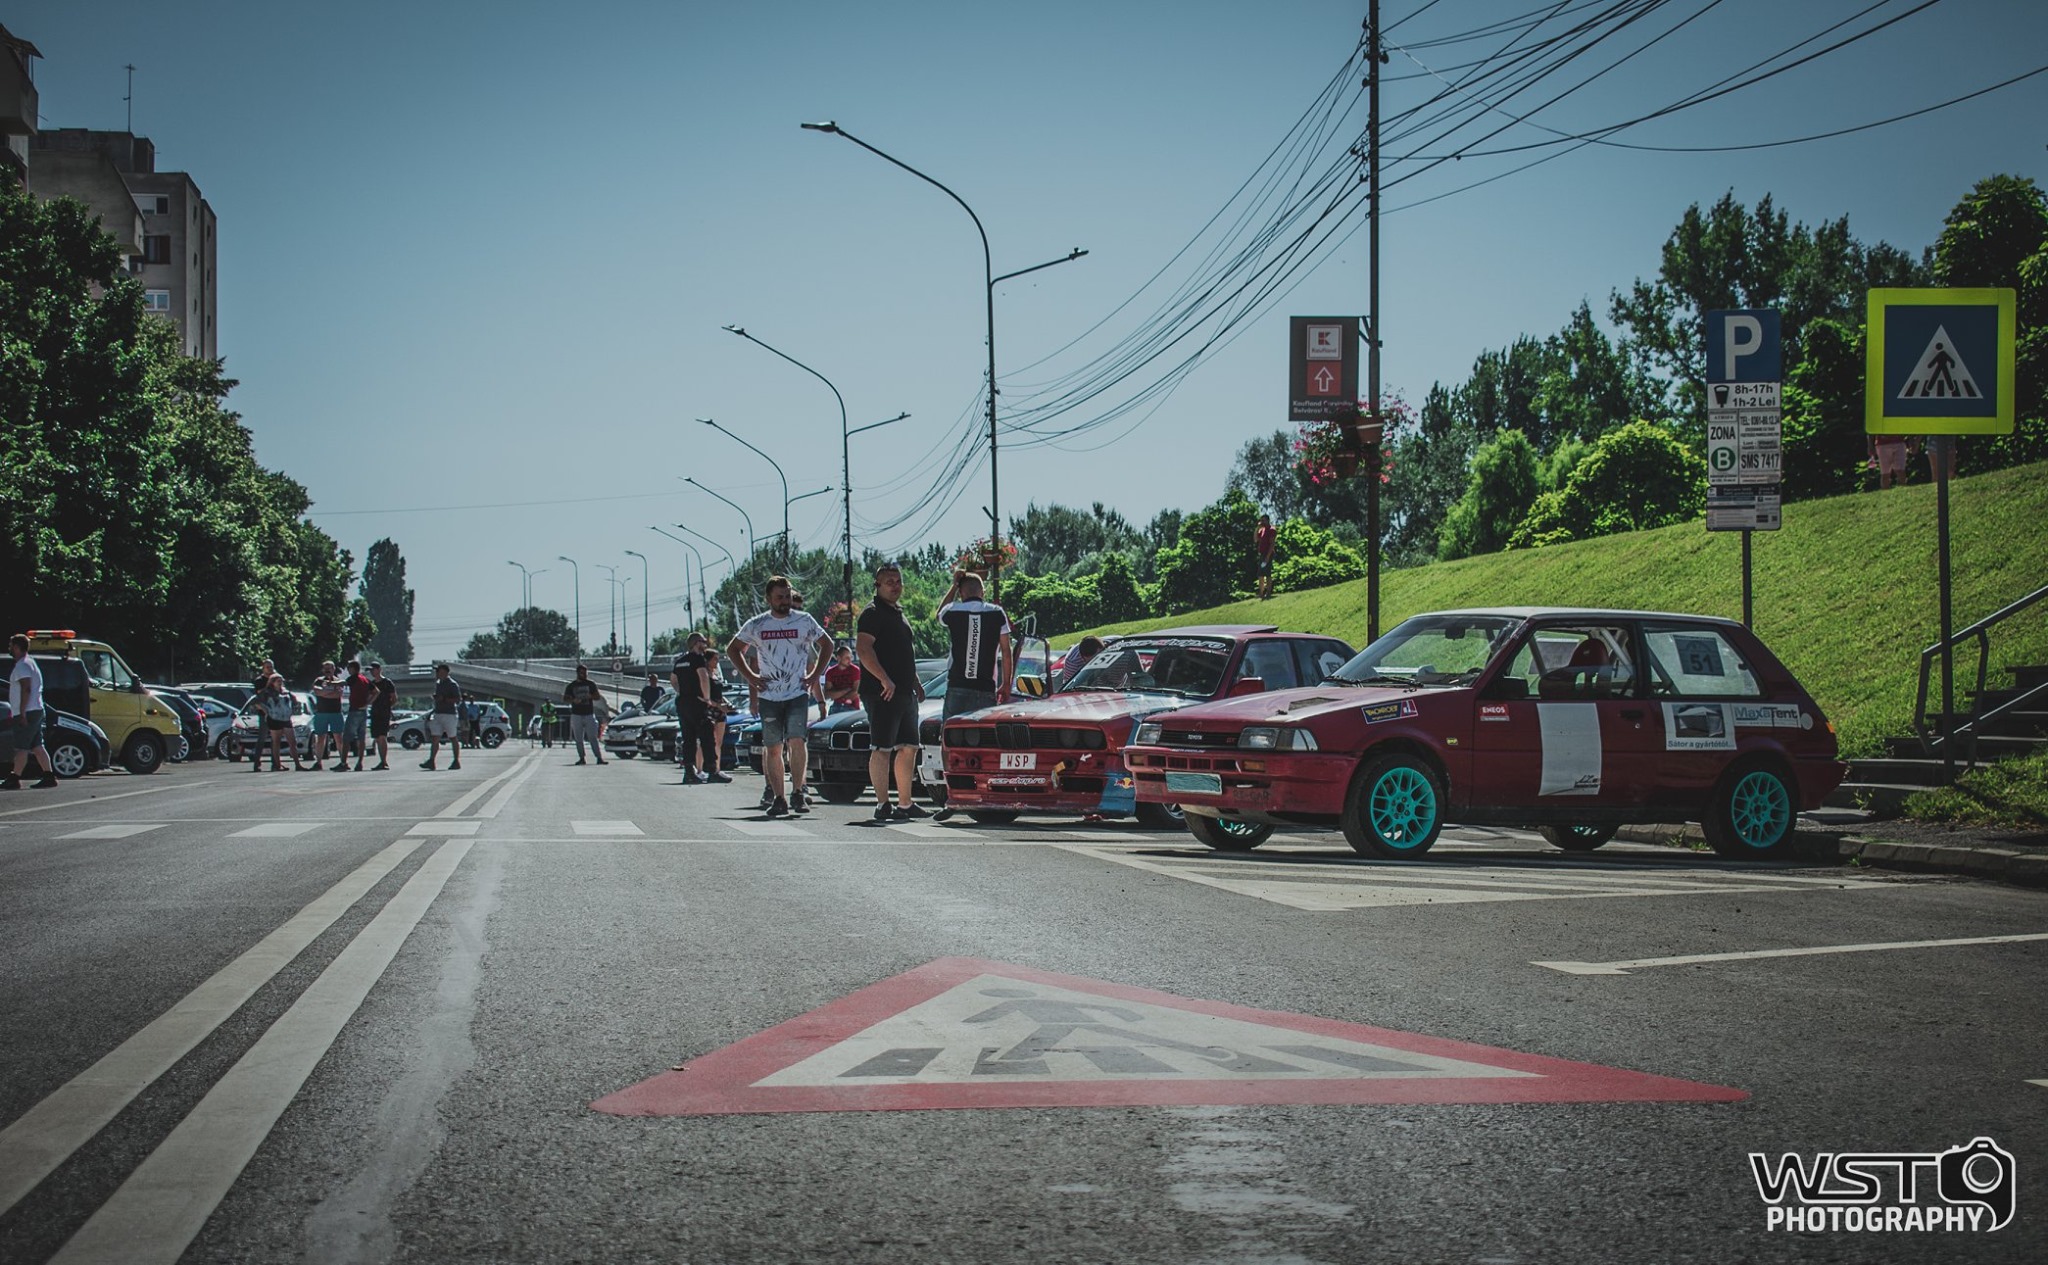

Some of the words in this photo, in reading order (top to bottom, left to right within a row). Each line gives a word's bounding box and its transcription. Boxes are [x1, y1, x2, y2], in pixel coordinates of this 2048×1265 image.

[1724, 315, 1763, 380] P
[1734, 384, 1774, 394] 8h-17h
[1732, 397, 1757, 407] 1h-2
[1758, 396, 1776, 407] Lei
[1710, 426, 1736, 440] ZONA
[1717, 449, 1731, 470] B
[1741, 454, 1759, 469] SMS
[1761, 453, 1780, 469] 7417
[969, 617, 980, 660] Motorsport
[967, 662, 976, 678] BMW
[1481, 706, 1506, 714] ENEOS
[1734, 706, 1798, 719] MaxaTent
[1667, 740, 1688, 748] Sátor
[1006, 754, 1030, 768] WSP
